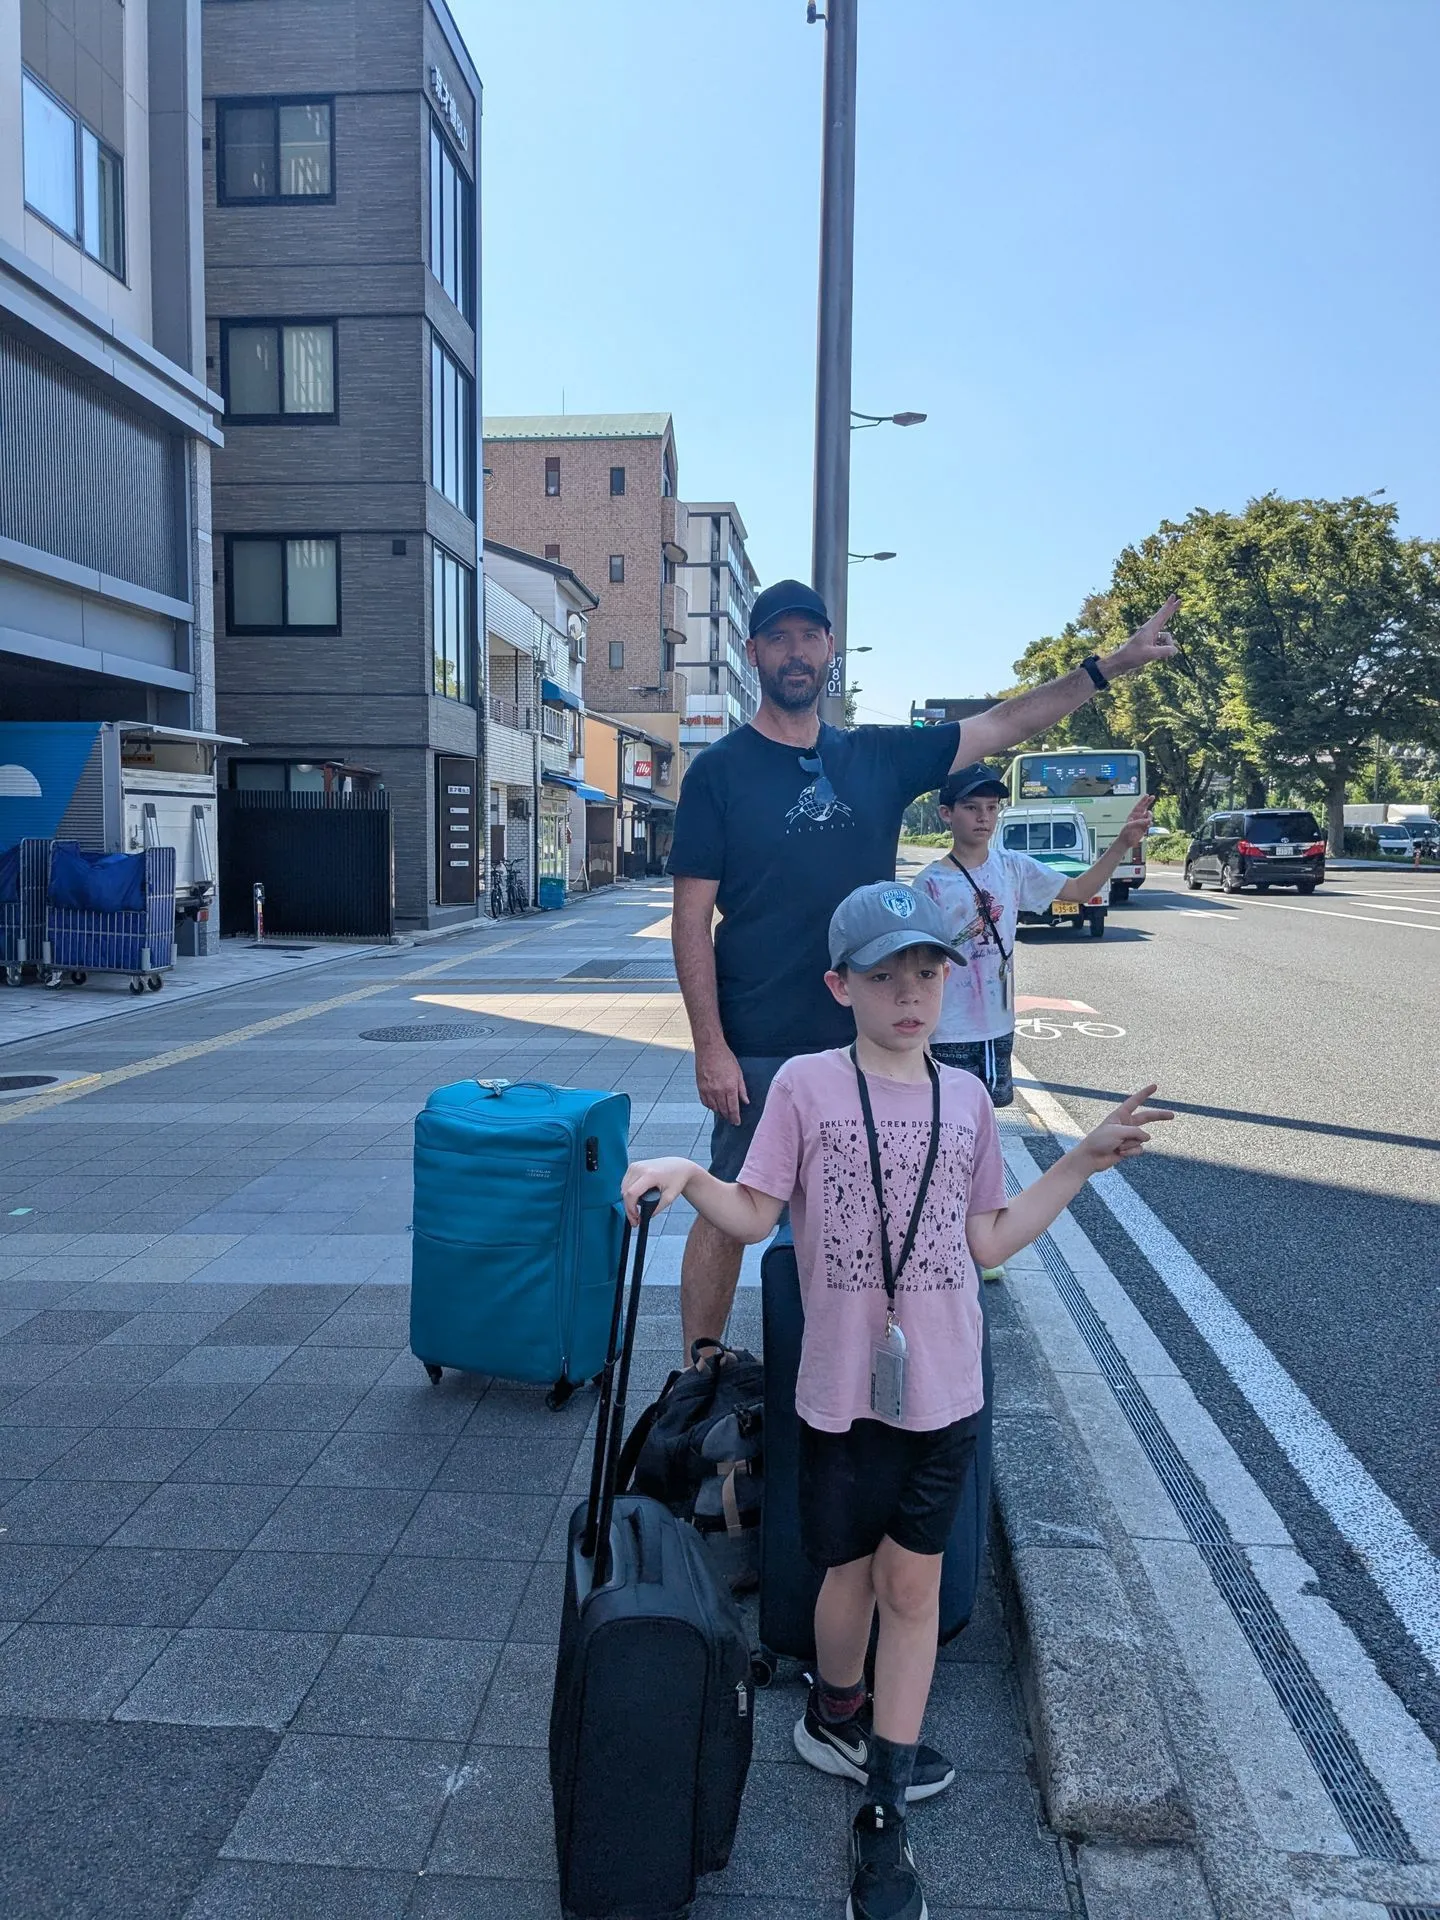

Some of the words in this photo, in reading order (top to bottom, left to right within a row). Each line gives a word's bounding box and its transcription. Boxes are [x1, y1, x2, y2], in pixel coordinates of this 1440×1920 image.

[832, 668, 840, 681] 8
[827, 680, 842, 693] 01
[679, 715, 701, 727] yal
[636, 763, 650, 776] illy
[820, 1119, 857, 1130] BRKLYN
[880, 1120, 907, 1128] CREW
[922, 1283, 933, 1291] NY
